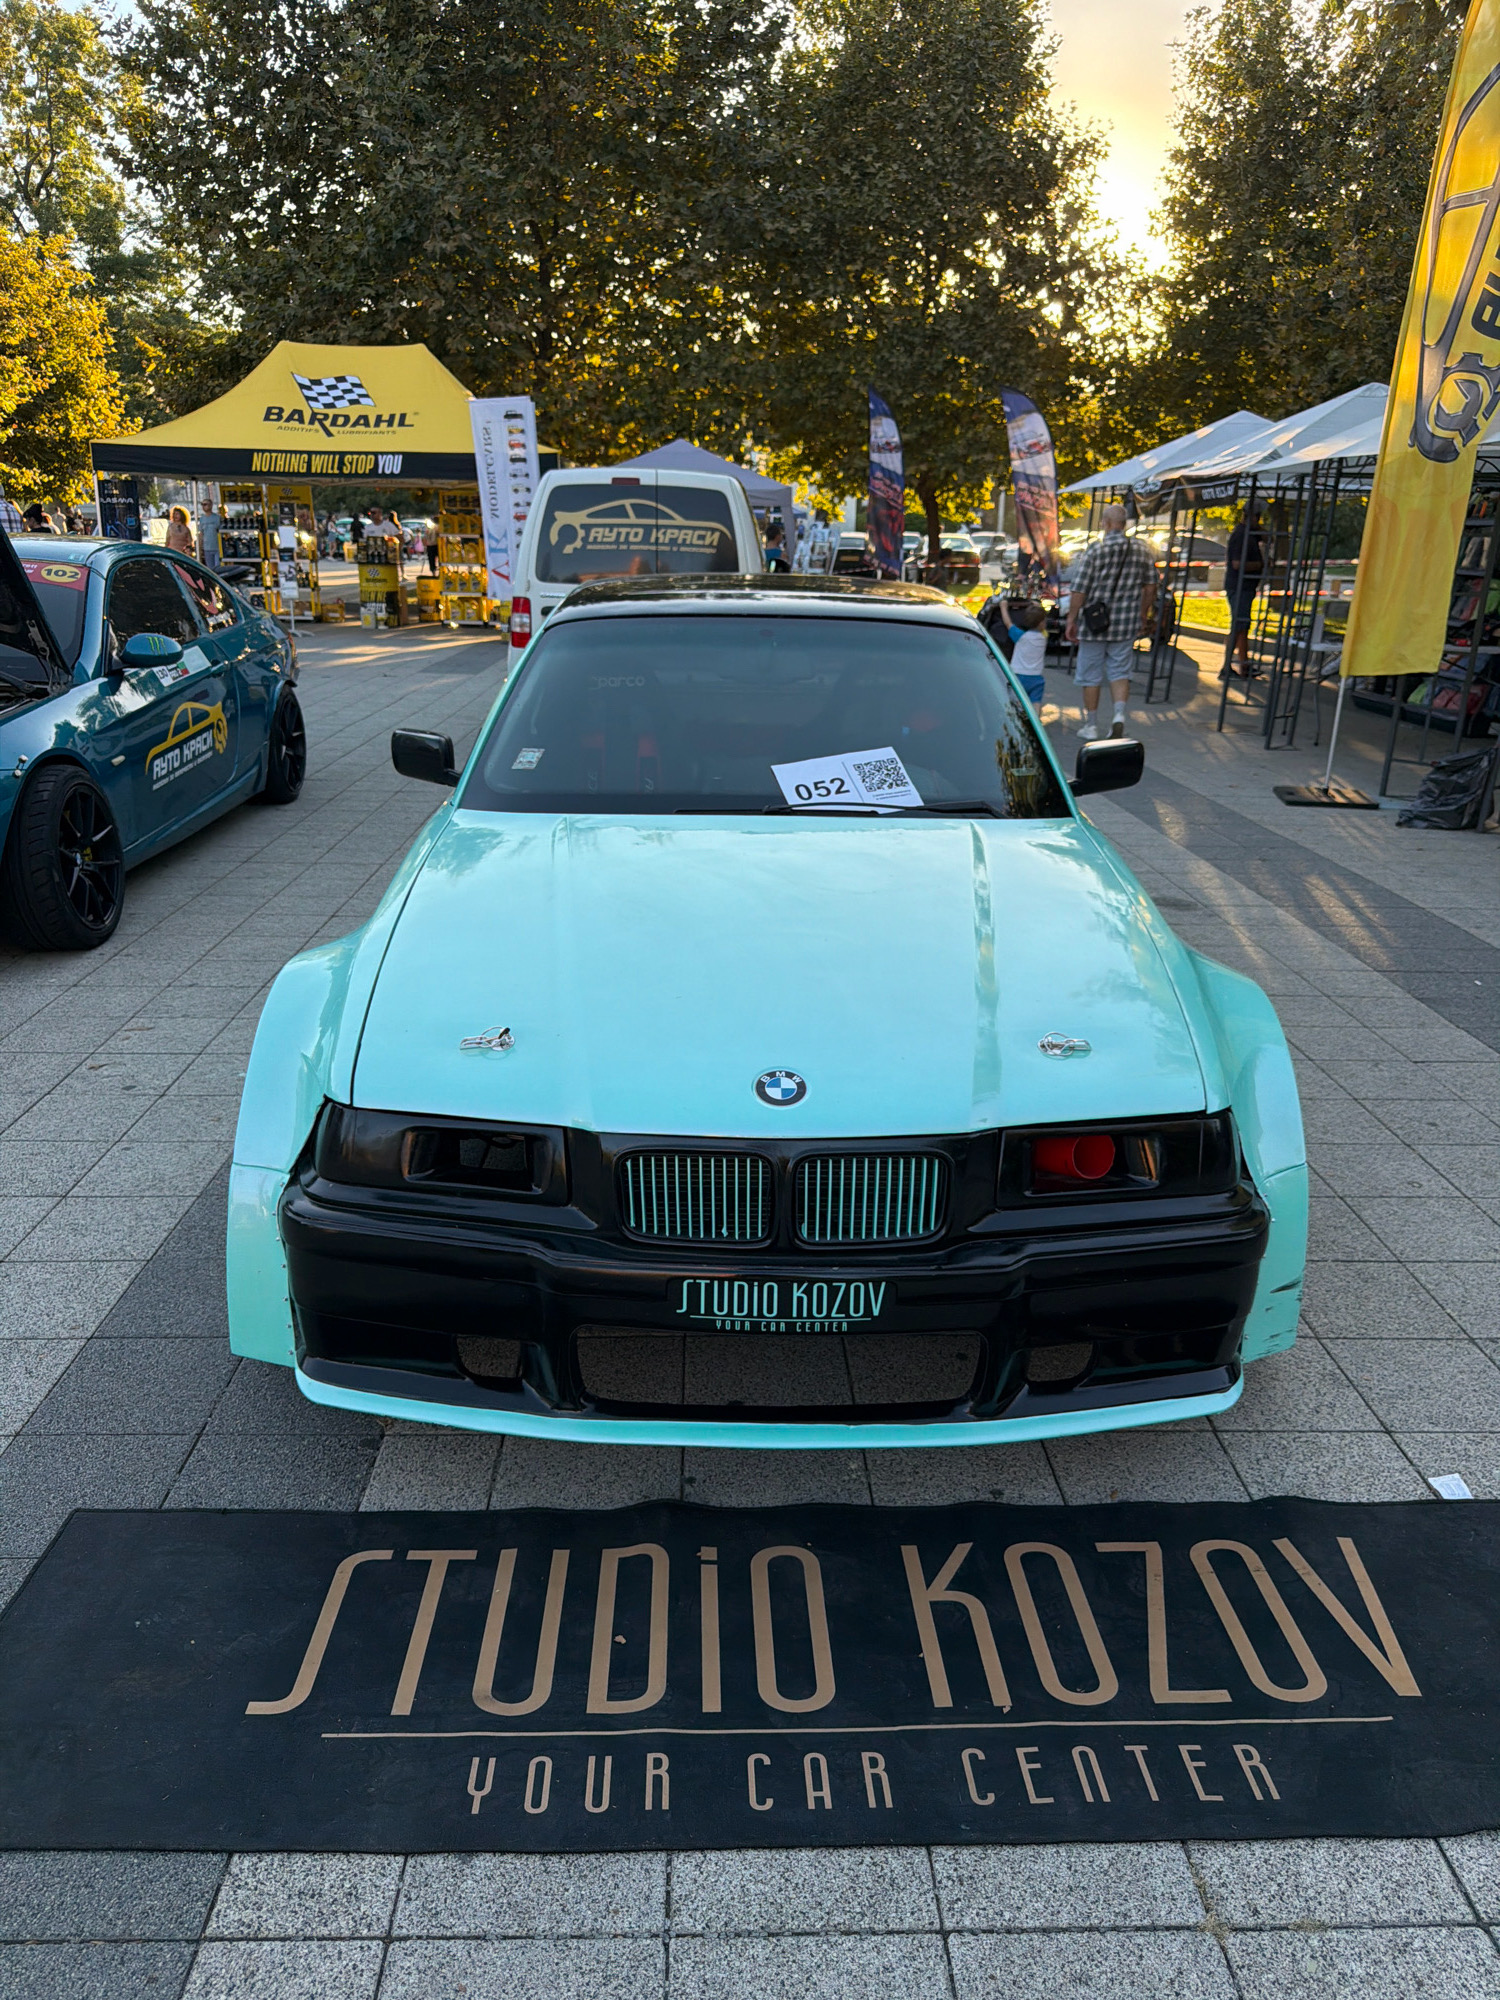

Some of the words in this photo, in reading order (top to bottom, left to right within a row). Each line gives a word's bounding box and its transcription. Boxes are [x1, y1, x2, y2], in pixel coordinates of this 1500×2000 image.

[263, 406, 415, 437] BARDAHL
[251, 452, 308, 474] NOTHING
[311, 454, 340, 474] WILL
[342, 454, 376, 475] STOP
[377, 454, 403, 475] YOU
[43, 568, 80, 580] 102
[794, 777, 850, 801] 052
[760, 1071, 802, 1083] BMW
[792, 1281, 886, 1318] KOZOV
[716, 1319, 750, 1331] YOUR
[761, 1321, 786, 1332] CAR
[796, 1321, 848, 1333] CENTER
[900, 1536, 1422, 1708] KOZOV
[467, 1752, 670, 1815] YOUR
[747, 1751, 894, 1811] CAR
[961, 1743, 1281, 1805] CENTER
